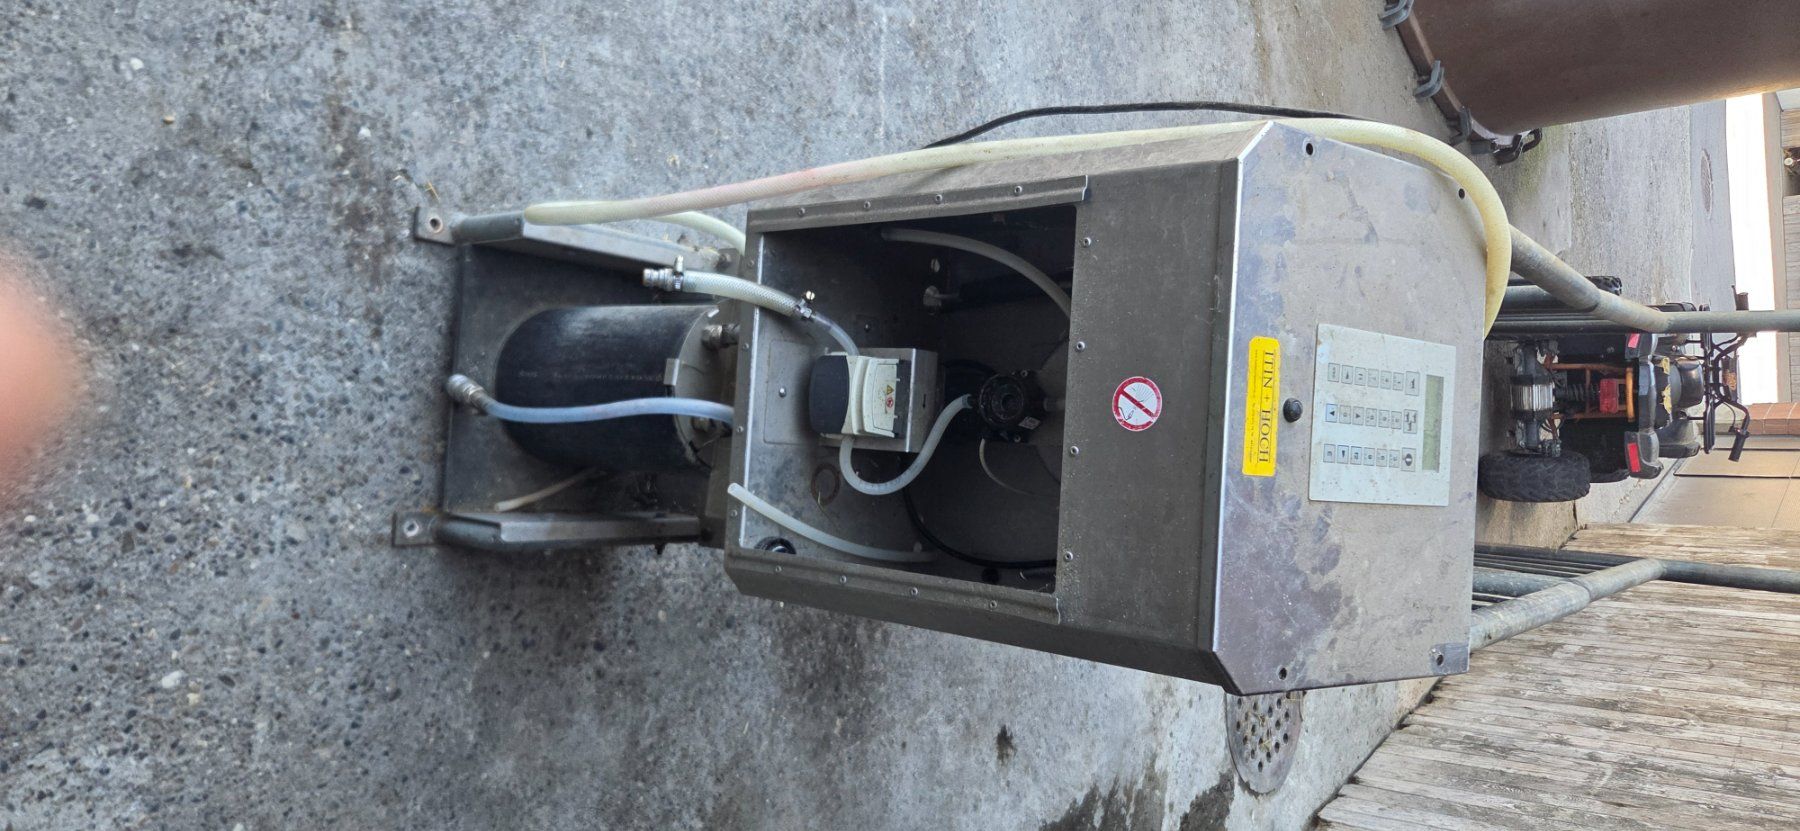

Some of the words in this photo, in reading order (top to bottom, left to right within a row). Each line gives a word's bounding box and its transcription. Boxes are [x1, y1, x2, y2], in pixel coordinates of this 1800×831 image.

[1263, 351, 1275, 389] ITIN
[1263, 394, 1271, 402] +
[1258, 409, 1272, 463] HOCH
